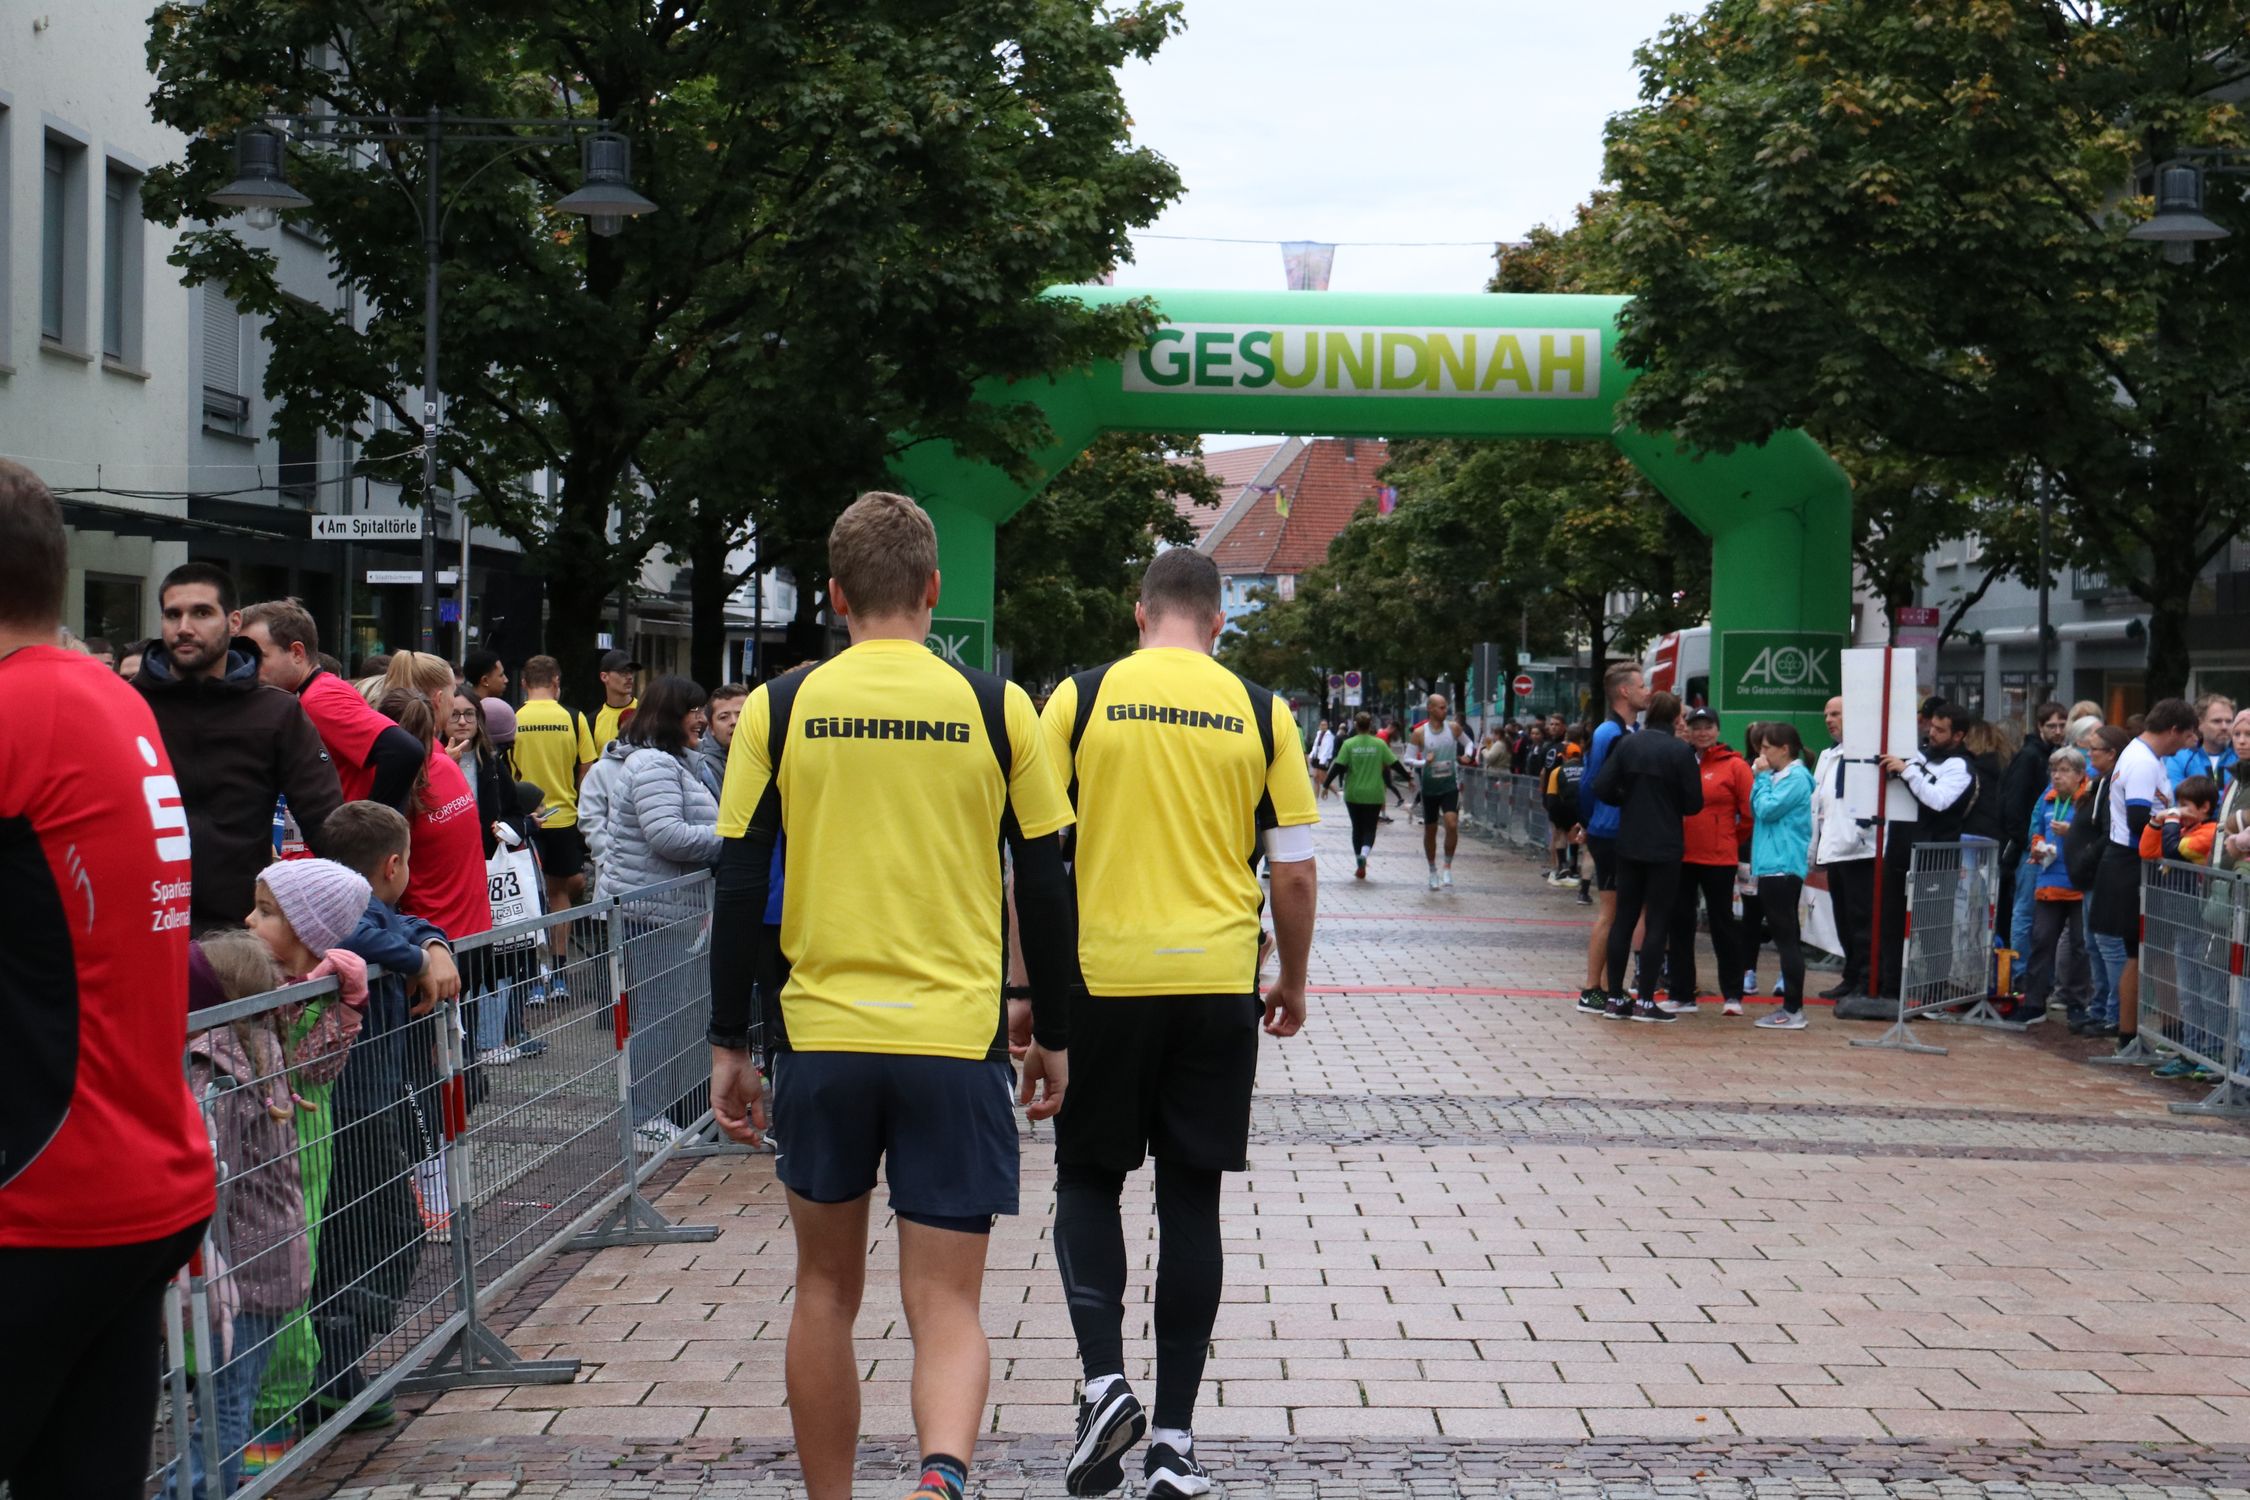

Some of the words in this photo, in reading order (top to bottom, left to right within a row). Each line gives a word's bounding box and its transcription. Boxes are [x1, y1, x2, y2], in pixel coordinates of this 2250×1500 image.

[1138, 328, 1586, 393] GESUNDNAH
[327, 519, 347, 534] Am
[352, 518, 417, 536] Spitaltörle
[1739, 646, 1830, 685] AOK
[1737, 686, 1750, 695] Die
[804, 717, 971, 743] GÜHRING
[1106, 703, 1245, 735] GÜHRING
